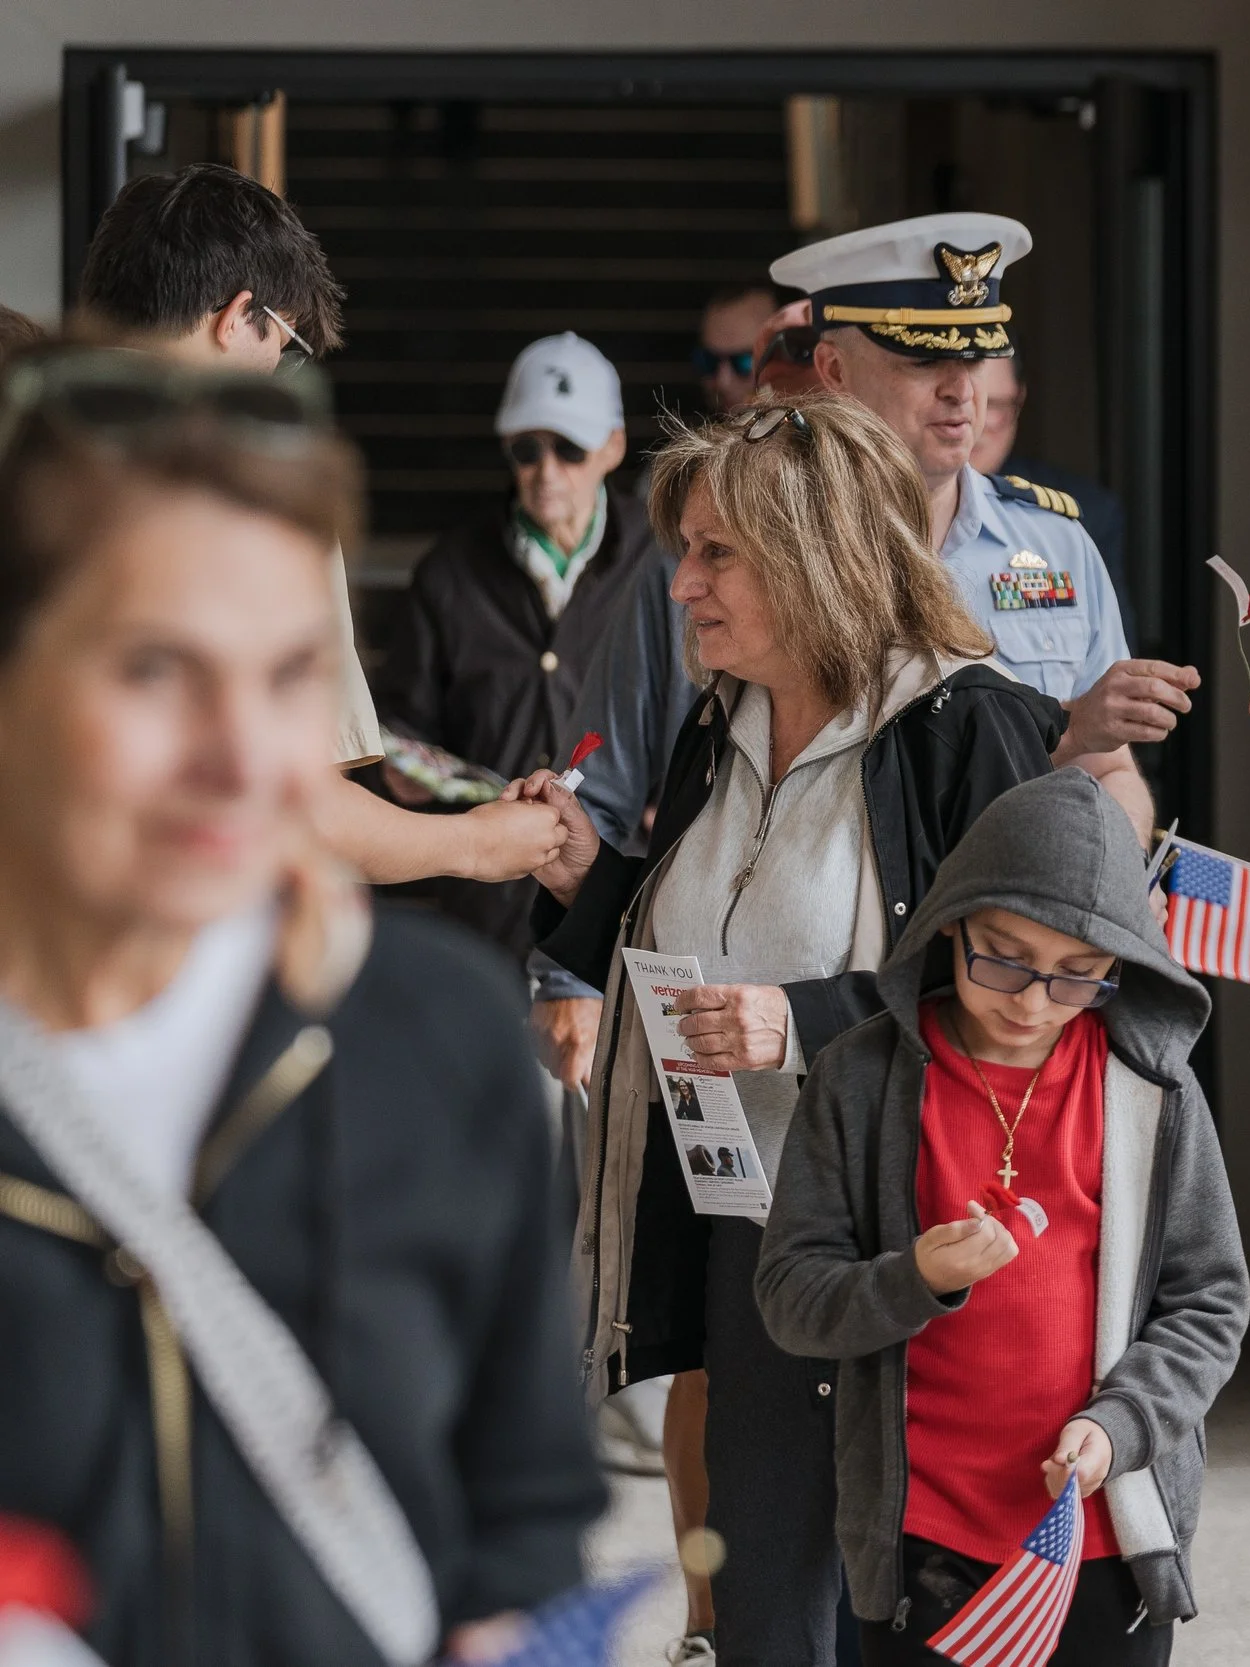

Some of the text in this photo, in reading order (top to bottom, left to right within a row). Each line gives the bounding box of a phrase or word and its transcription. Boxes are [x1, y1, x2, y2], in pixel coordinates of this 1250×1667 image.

[634, 961, 693, 979] THANK YOU
[650, 984, 687, 998] verizo
